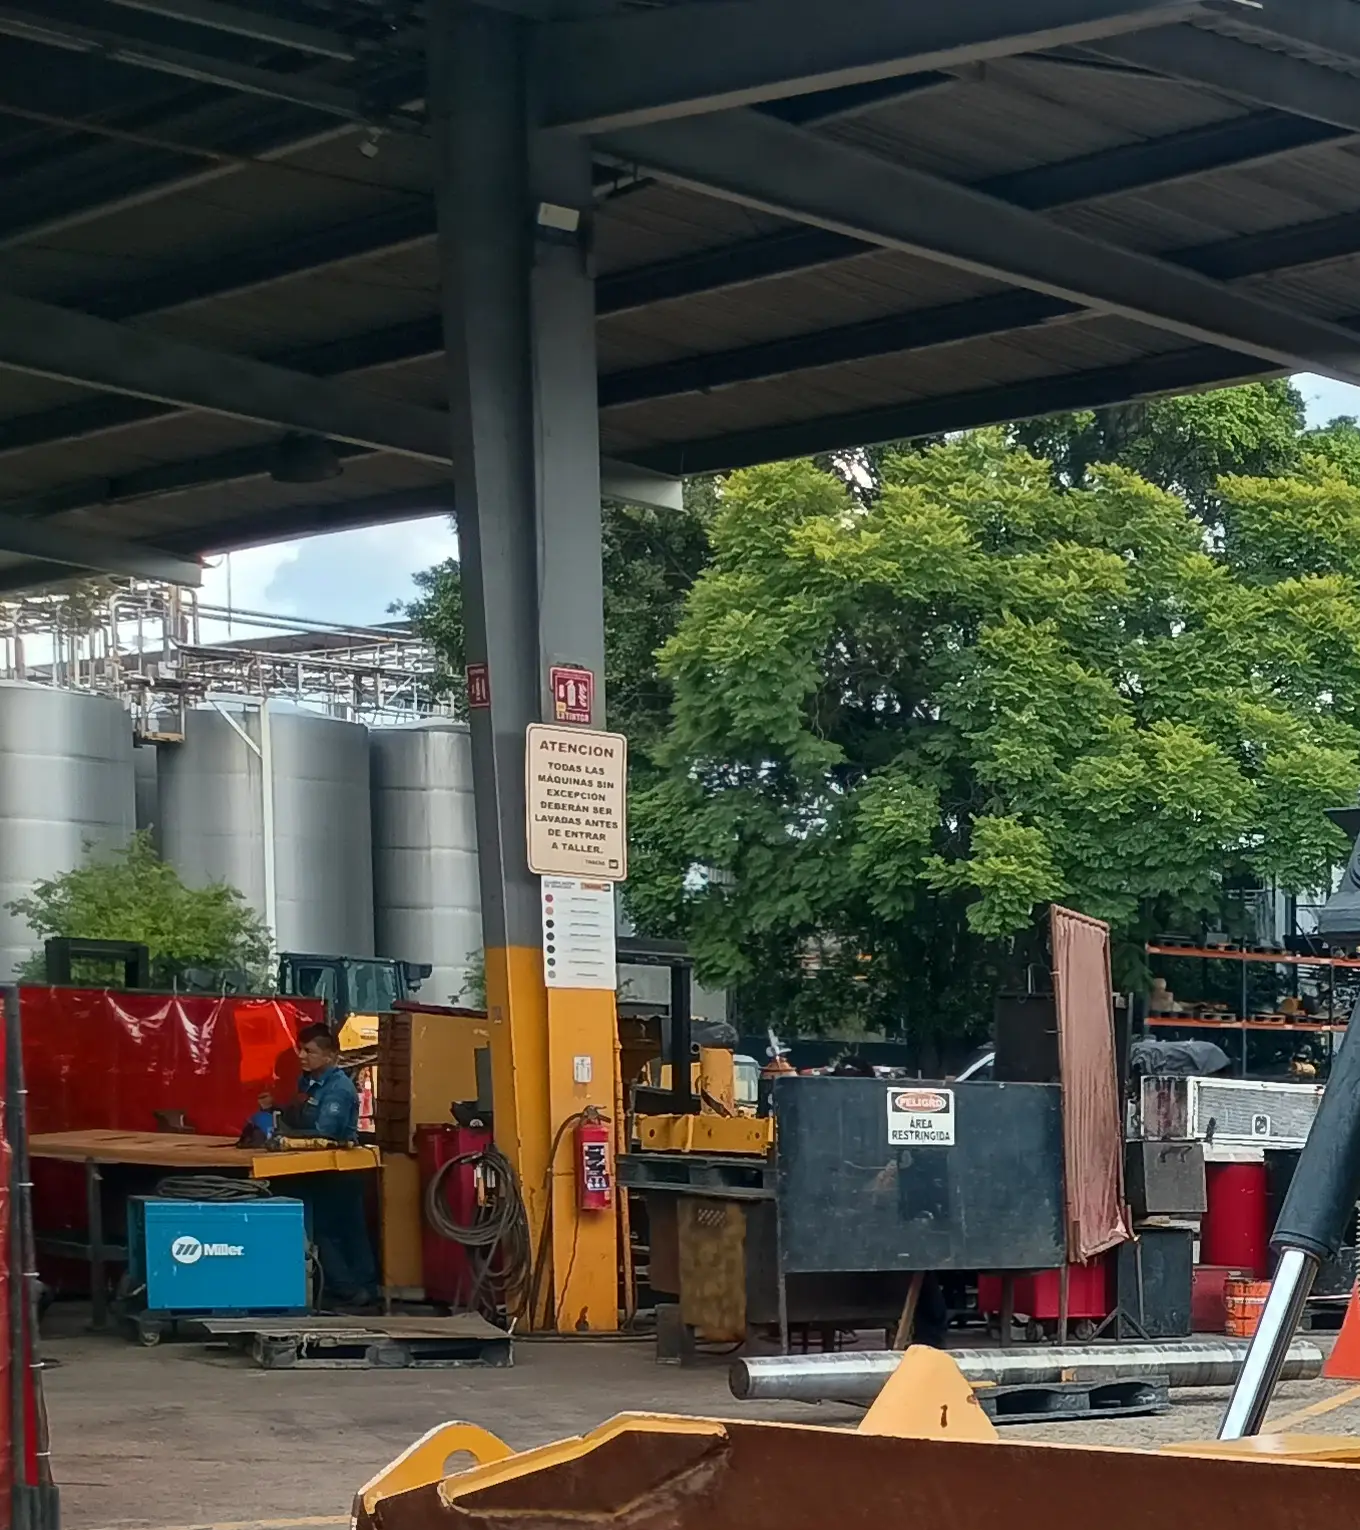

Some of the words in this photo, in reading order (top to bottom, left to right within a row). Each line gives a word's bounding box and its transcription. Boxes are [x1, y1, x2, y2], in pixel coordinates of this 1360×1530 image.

[548, 762, 582, 773] TODAS
[585, 766, 604, 775] LAS
[597, 781, 614, 789] SIN
[592, 806, 612, 815] SER
[534, 814, 581, 825] LAVADAS
[585, 819, 618, 829] ANTES
[547, 829, 561, 837] DE
[564, 830, 606, 841] ENTRAR
[551, 842, 558, 850] A
[892, 1130, 950, 1141] RESTRINGIDA
[203, 1243, 245, 1256] Miller
